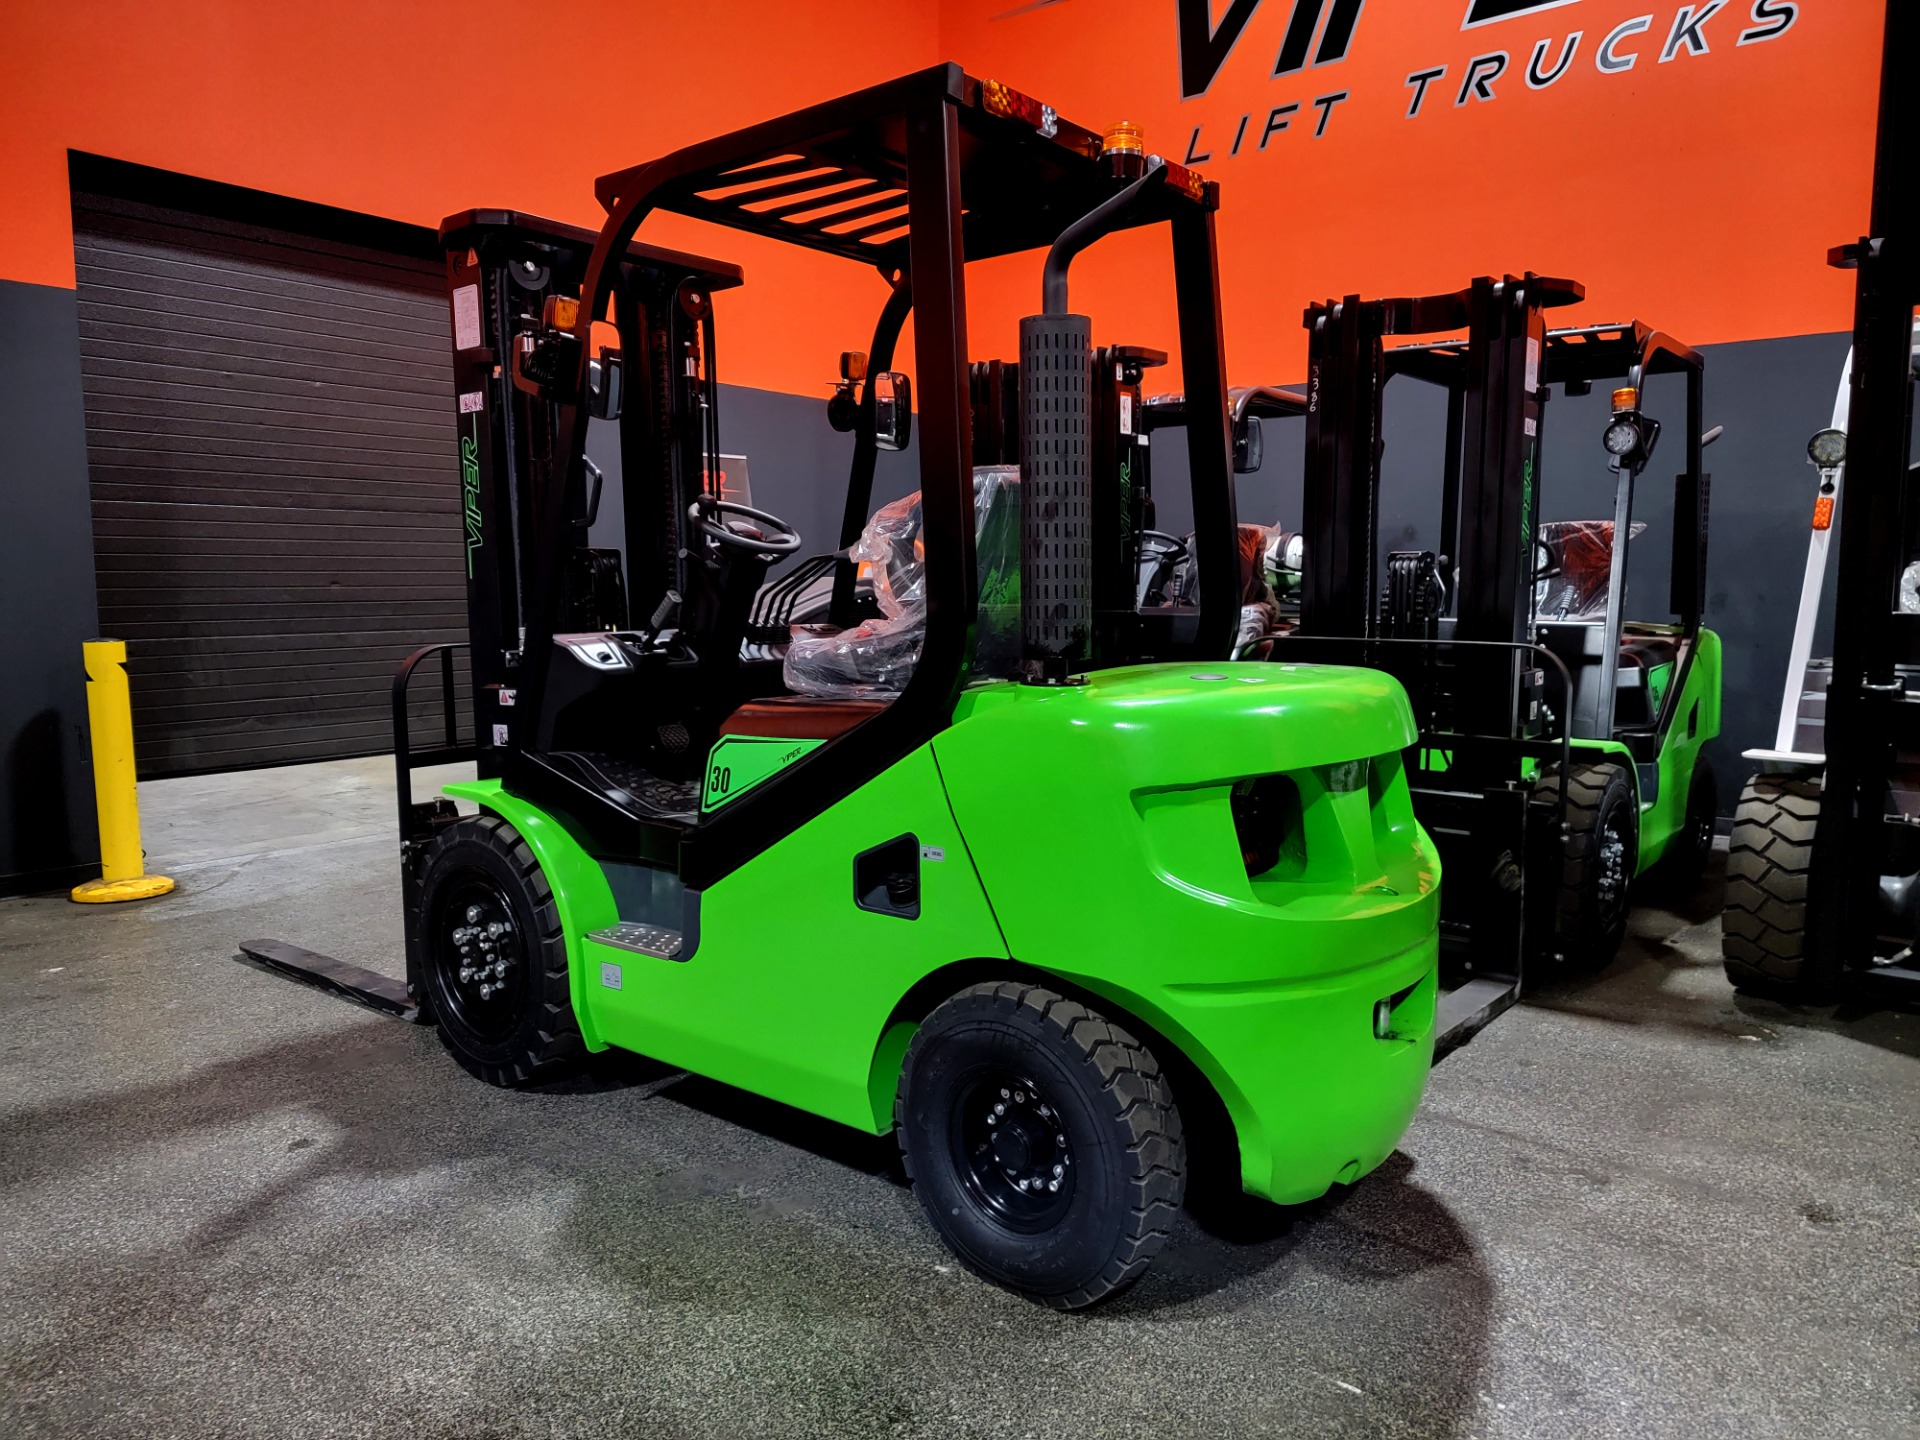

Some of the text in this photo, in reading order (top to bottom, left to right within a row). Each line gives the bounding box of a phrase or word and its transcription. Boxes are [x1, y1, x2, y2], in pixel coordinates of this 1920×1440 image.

[1183, 89, 1351, 167] LIFT
[1404, 0, 1799, 119] TRUCKS
[462, 413, 483, 579] VIPER
[1120, 448, 1130, 560] VIPER
[710, 765, 731, 794] 30
[777, 746, 805, 764] VIPER
